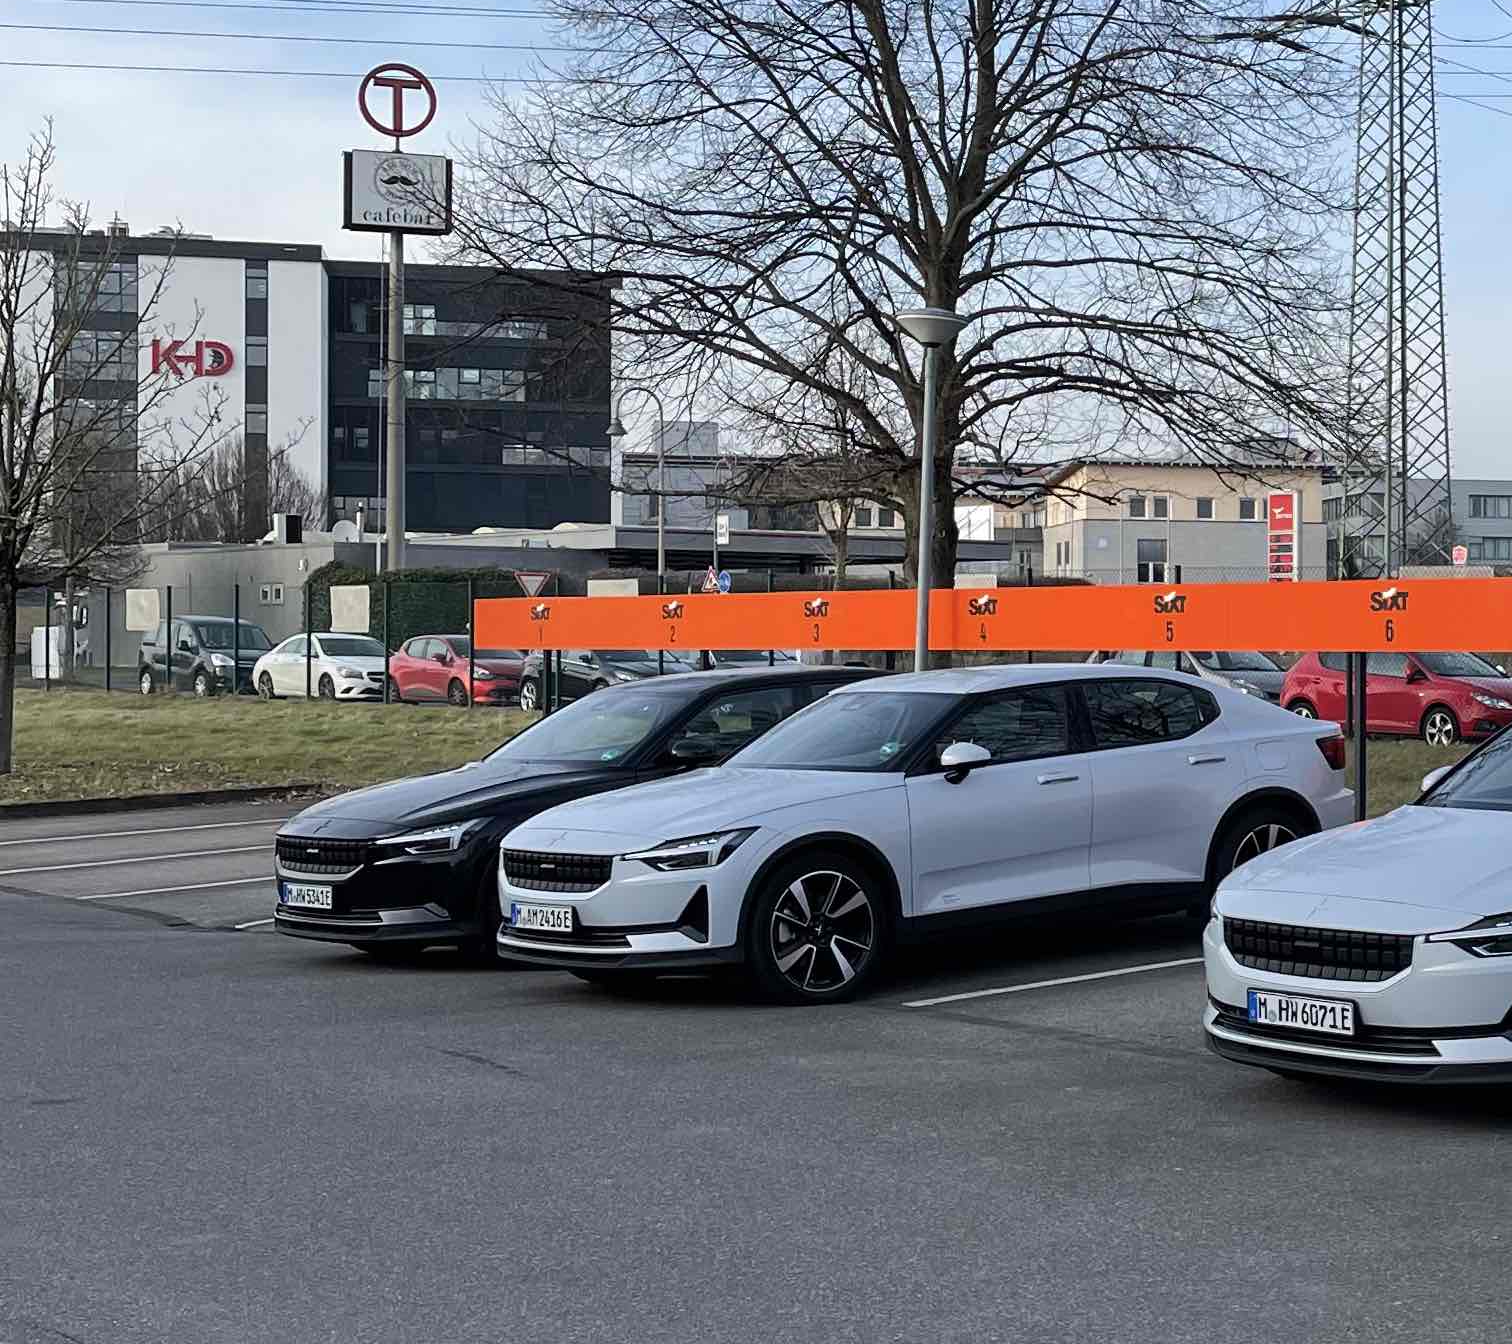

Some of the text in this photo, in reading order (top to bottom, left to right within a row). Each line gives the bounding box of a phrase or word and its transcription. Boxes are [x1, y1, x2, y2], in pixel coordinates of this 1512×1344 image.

[362, 206, 436, 225] cafebar
[669, 625, 676, 643] 2
[813, 623, 820, 642] 3
[979, 622, 987, 642] 4
[1166, 620, 1174, 642] 5
[1385, 619, 1394, 642] 6
